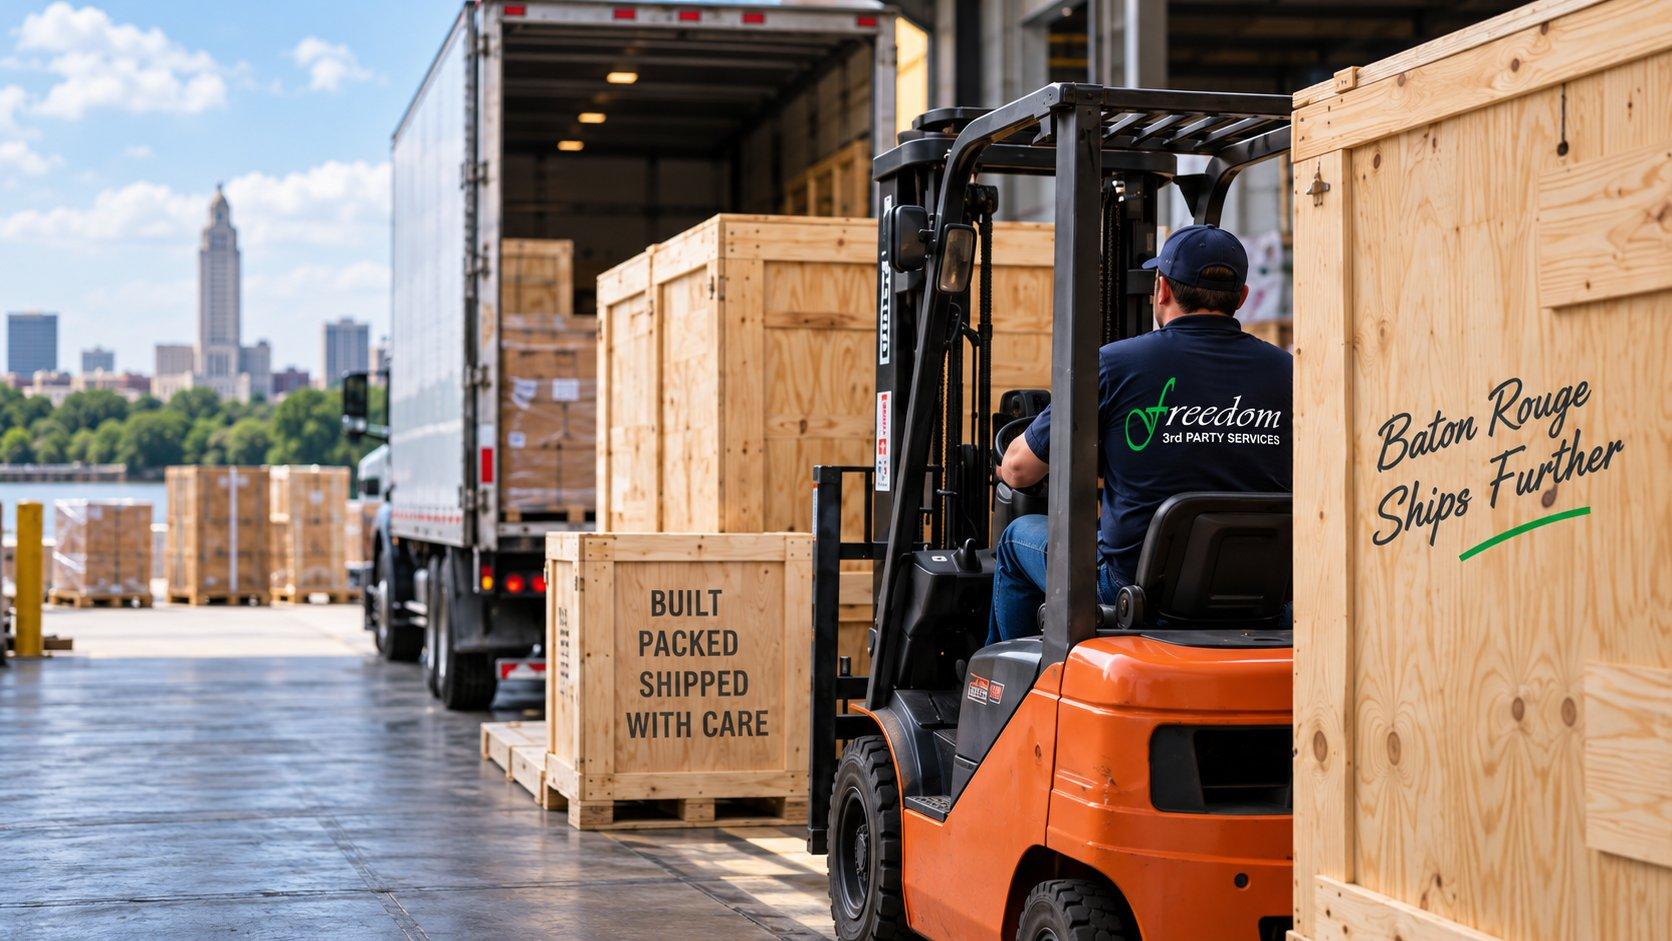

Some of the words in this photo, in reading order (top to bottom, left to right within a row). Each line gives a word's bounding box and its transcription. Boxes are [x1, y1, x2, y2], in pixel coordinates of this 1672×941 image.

[1125, 377, 1281, 452] freedom
[1377, 410, 1477, 473] Baton
[1488, 377, 1591, 438] Rouge
[1162, 432, 1182, 443] 3rd
[1186, 432, 1224, 443] PARTY
[1227, 433, 1280, 445] SERVICES
[1372, 480, 1472, 547] Ships
[1490, 428, 1624, 509] Further
[651, 589, 722, 617] BUILT
[639, 629, 738, 657] PACKED
[639, 670, 749, 698] SHIPPED
[626, 711, 692, 738] WITH
[702, 710, 769, 738] CARE
